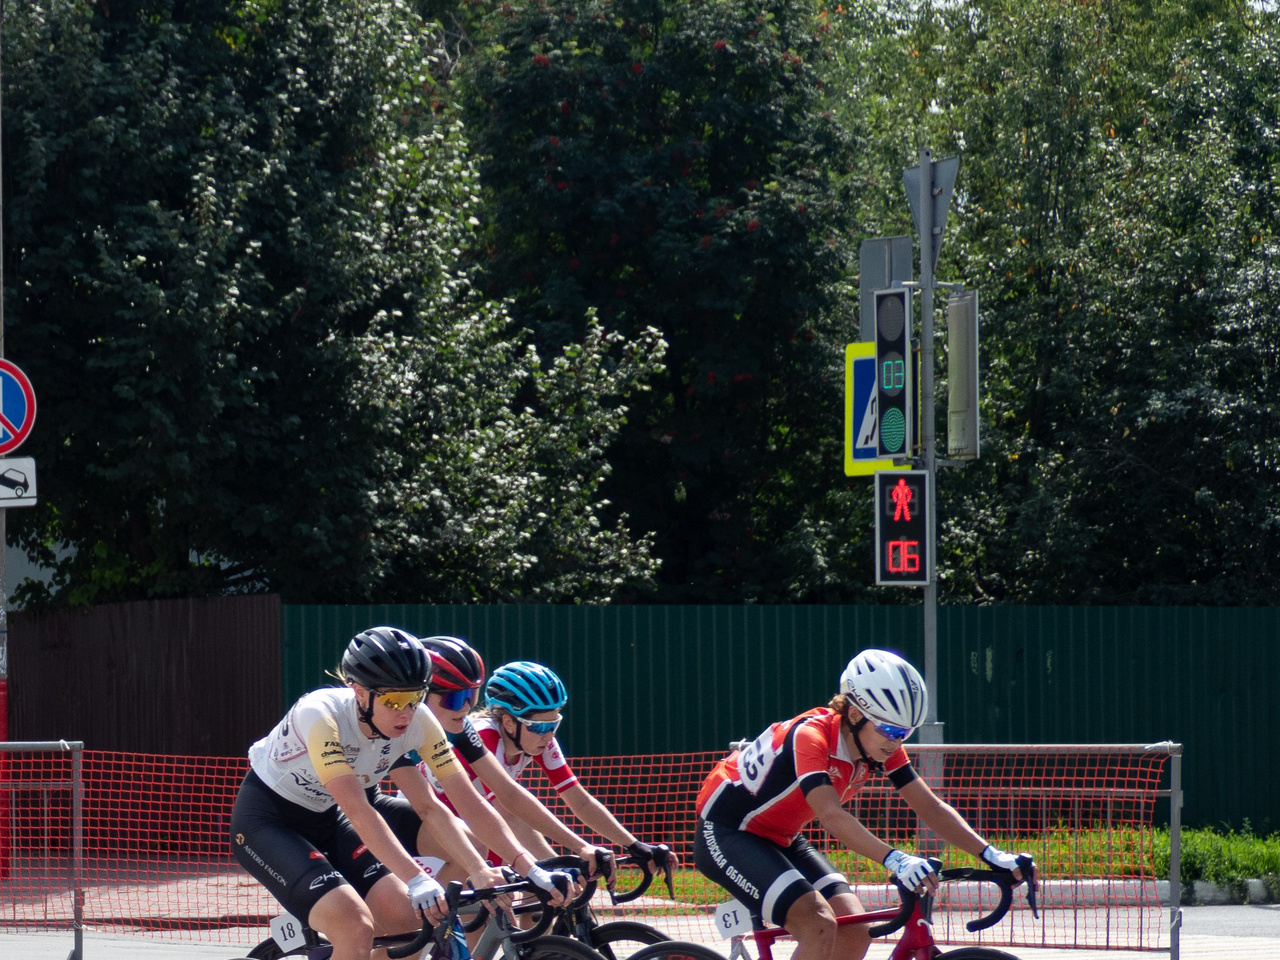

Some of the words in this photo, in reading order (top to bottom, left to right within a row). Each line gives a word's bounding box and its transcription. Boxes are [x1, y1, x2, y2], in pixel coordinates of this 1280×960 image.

[883, 360, 904, 389] 03
[888, 541, 920, 573] 06
[243, 845, 265, 867] ASTERO
[264, 863, 287, 887] FALCON
[725, 865, 760, 899] ОБЛАСТЬ
[280, 922, 296, 941] 18
[722, 910, 740, 928] 13
